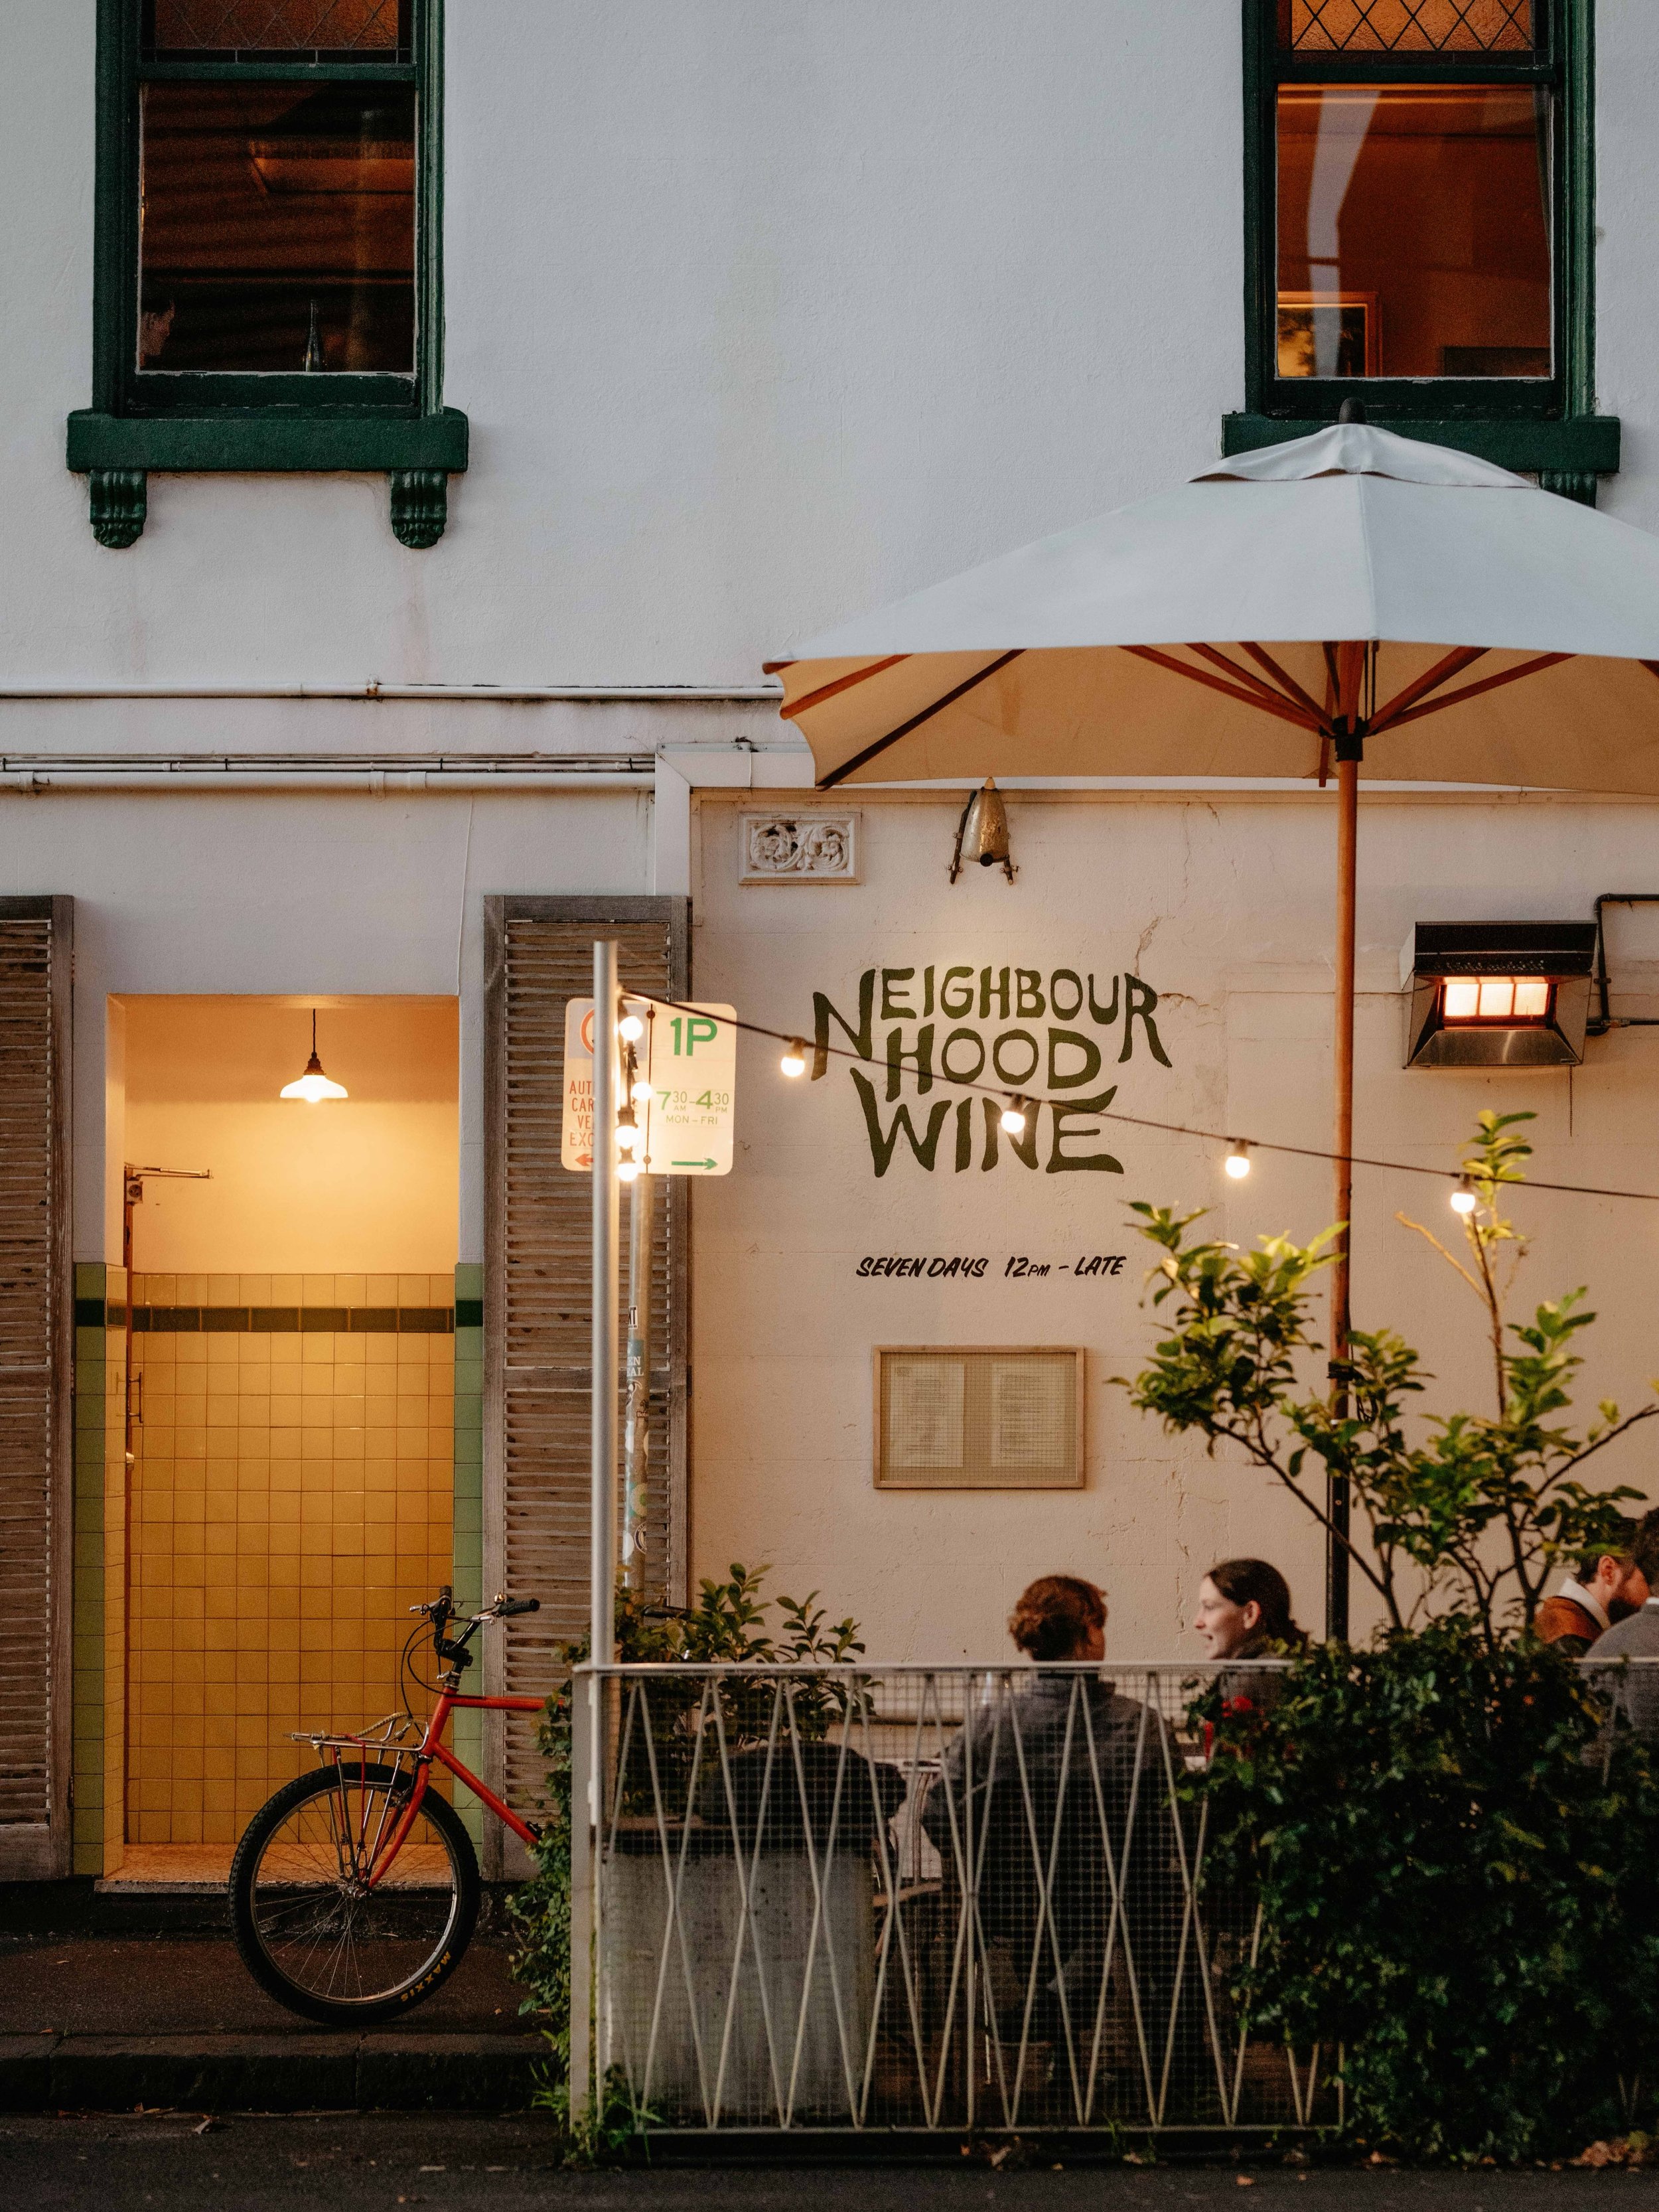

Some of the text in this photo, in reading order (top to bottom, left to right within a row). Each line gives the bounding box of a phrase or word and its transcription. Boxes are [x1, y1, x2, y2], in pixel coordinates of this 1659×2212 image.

[670, 1017, 718, 1057] 1P
[811, 965, 1173, 1080] NEIGHBOUR
[885, 1023, 1102, 1102] HOOD
[666, 1115, 689, 1124] MON
[701, 1116, 718, 1125] FRI
[849, 1085, 1124, 1178] WINE
[855, 1256, 927, 1278] SEVEN
[926, 1257, 989, 1278] DAYS
[1074, 1256, 1127, 1277] LATE
[400, 1951, 451, 2002] MAXXIS
